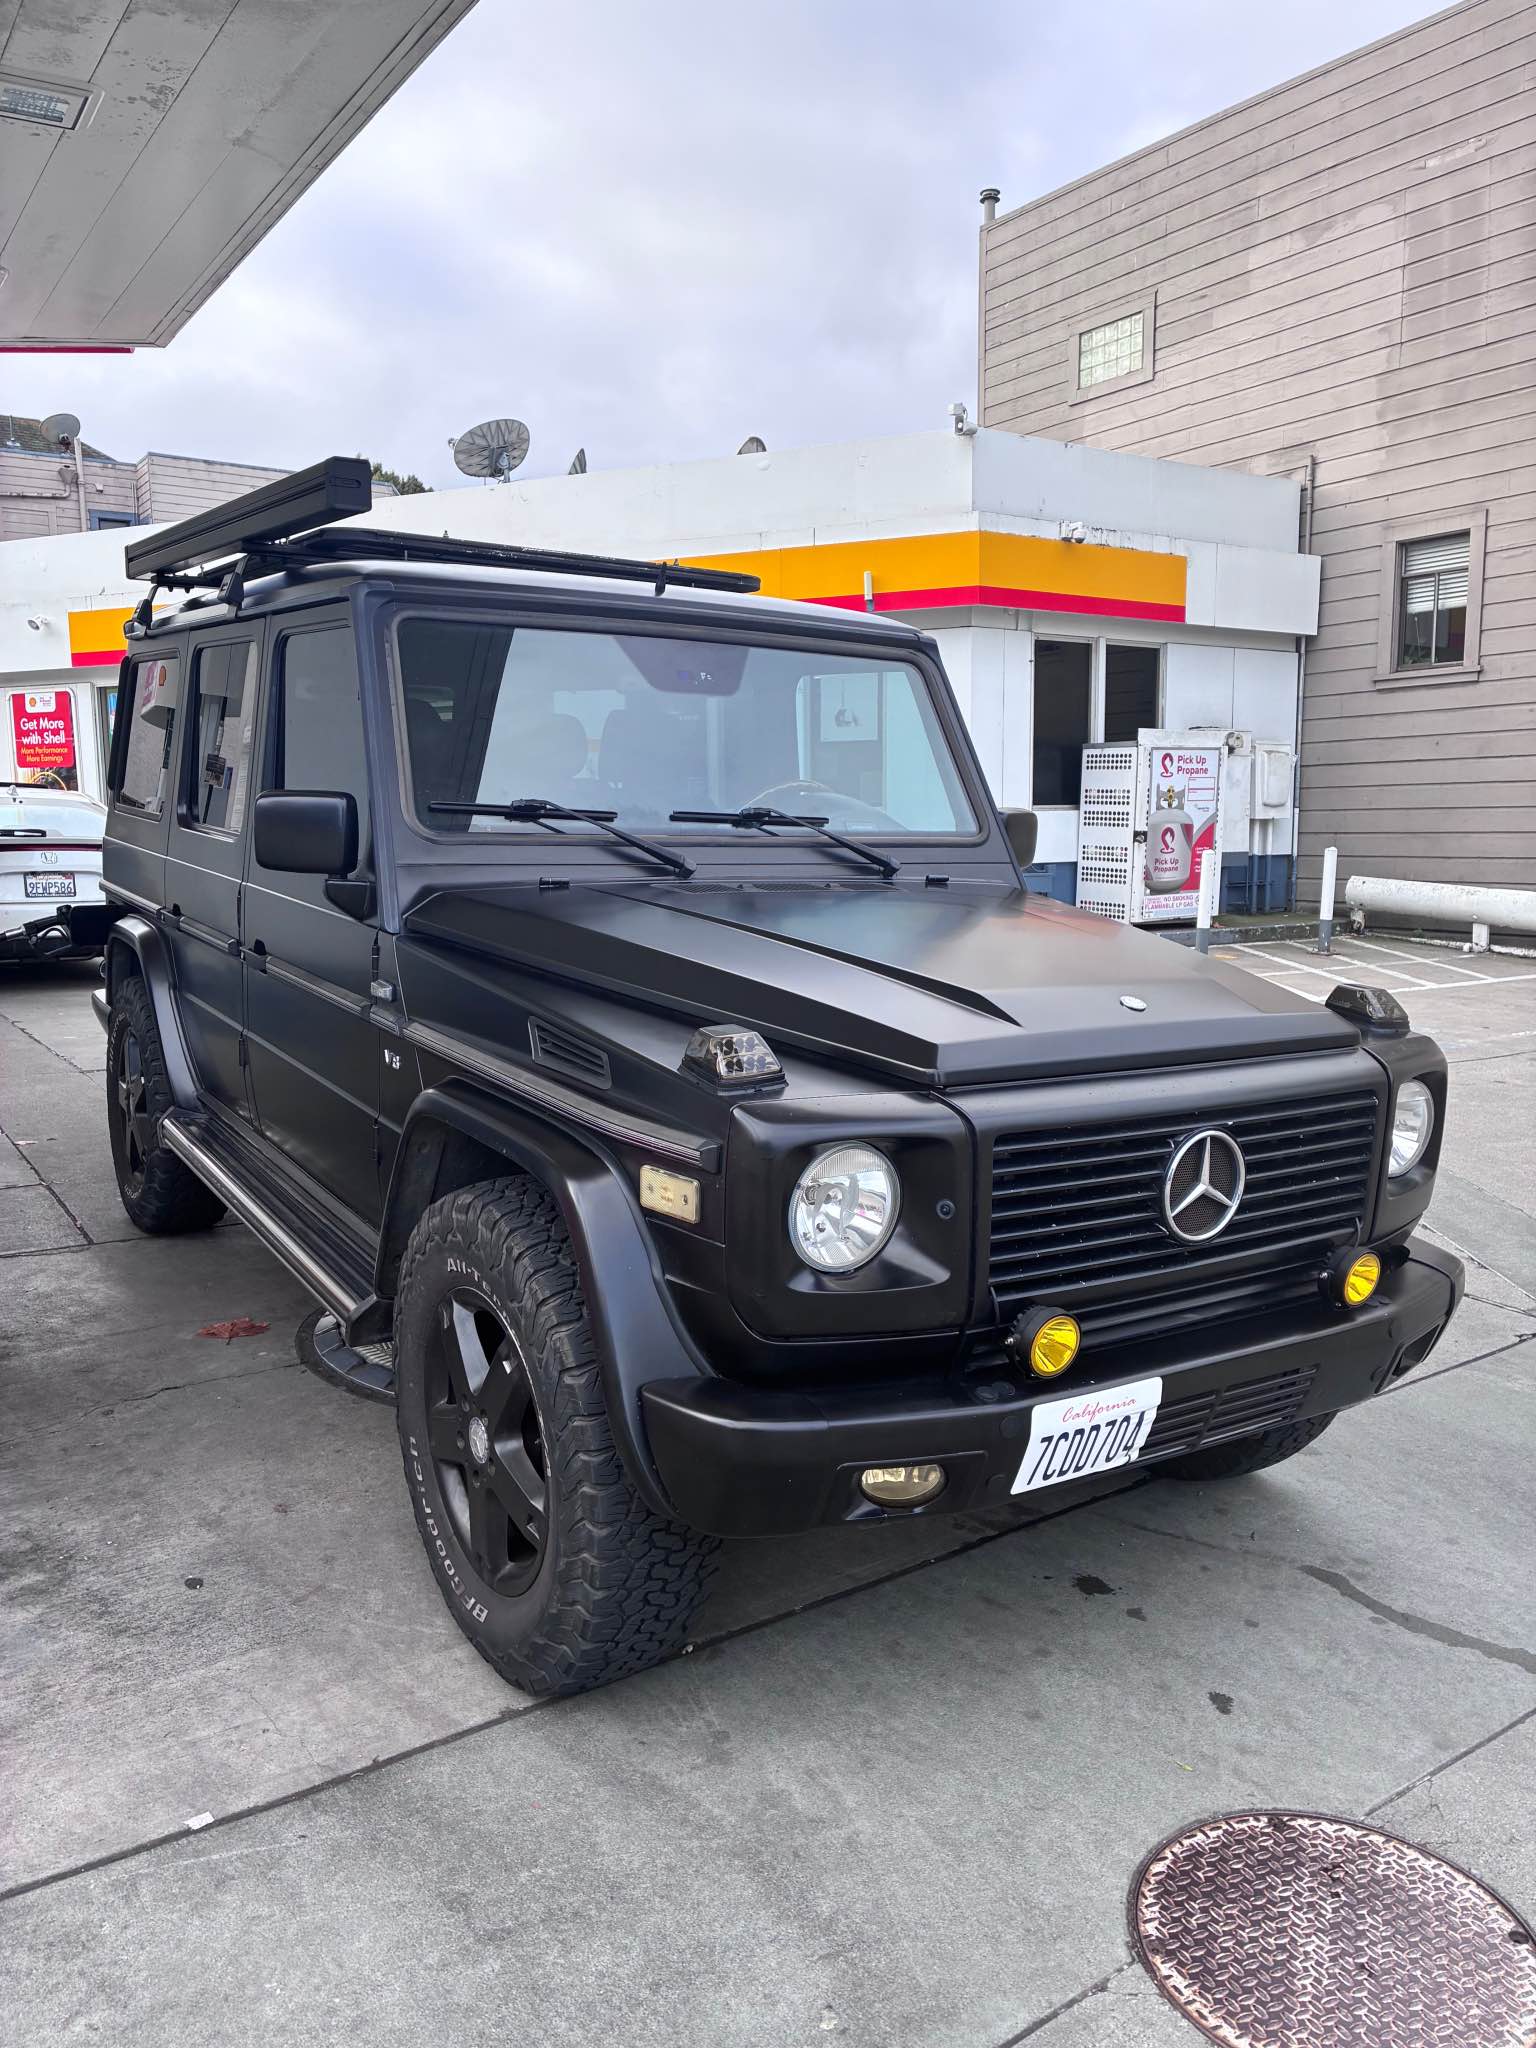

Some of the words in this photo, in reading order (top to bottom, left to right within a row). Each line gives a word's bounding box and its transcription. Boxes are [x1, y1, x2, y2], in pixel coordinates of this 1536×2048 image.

[21, 717, 37, 730] Get
[40, 716, 64, 730] More
[22, 731, 41, 745] with
[43, 729, 65, 744] Shell
[36, 745, 67, 754] Performance
[27, 754, 39, 763] More
[41, 754, 63, 764] Earnings
[1178, 755, 1193, 765] Pick
[1196, 755, 1206, 766] Up
[1177, 766, 1209, 776] Propane
[1154, 858, 1169, 866] Pick
[1170, 857, 1180, 866] Up
[1153, 865, 1179, 873] Propane
[1062, 1397, 1137, 1423] California
[1027, 1410, 1146, 1485] 7CDD704
